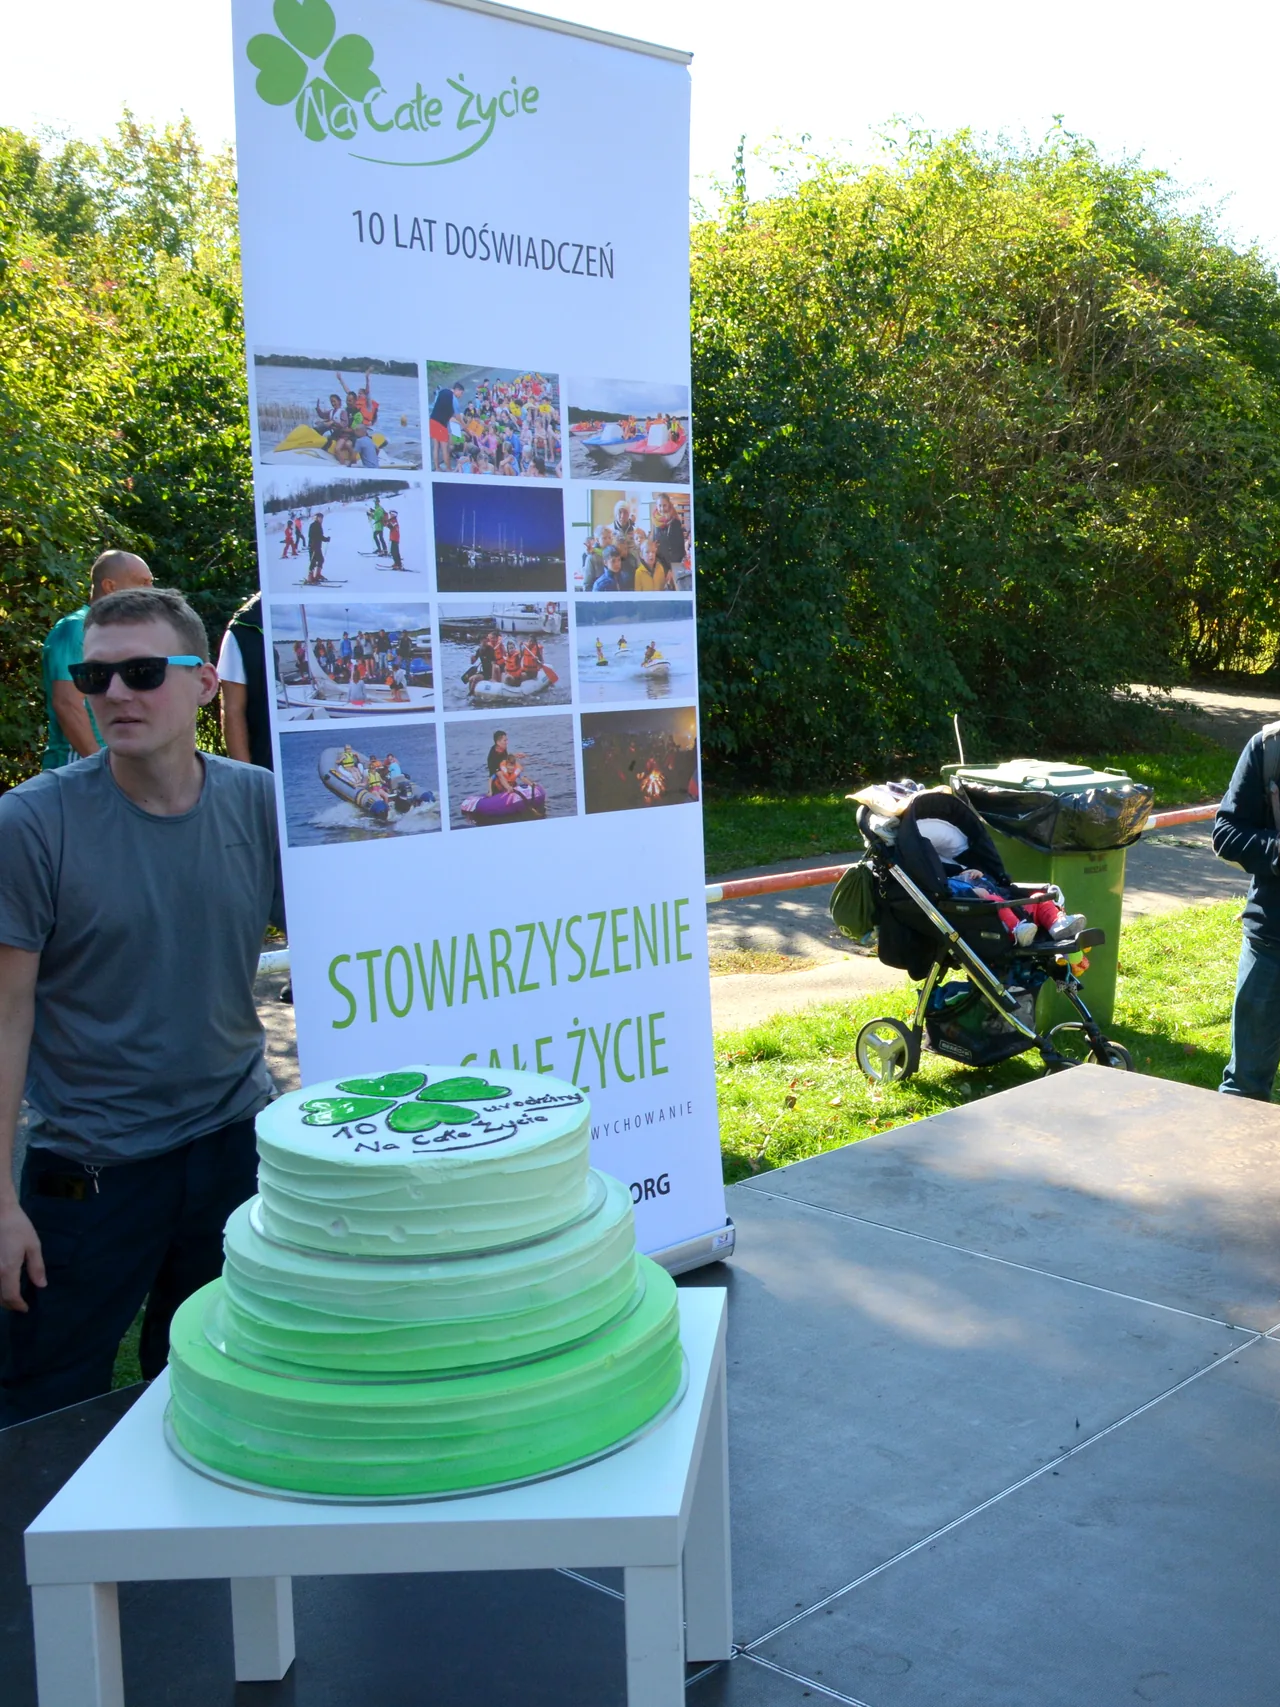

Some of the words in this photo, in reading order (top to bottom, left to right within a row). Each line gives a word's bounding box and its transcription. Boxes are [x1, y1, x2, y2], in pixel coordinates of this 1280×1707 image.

[302, 86, 357, 134] Na
[447, 73, 539, 145] Życie
[352, 210, 385, 245] 10
[394, 214, 437, 252] LAT
[445, 222, 614, 279] DOŚWIADCZEŃ
[327, 897, 693, 1029] STOWARZYSZENIE
[567, 1010, 669, 1093] ŻYCIE
[333, 1122, 377, 1139] 10
[483, 1093, 585, 1112] urodziny
[591, 1101, 693, 1140] WYCHOWANIE
[354, 1141, 401, 1153] Na
[629, 1173, 671, 1205] ORG
